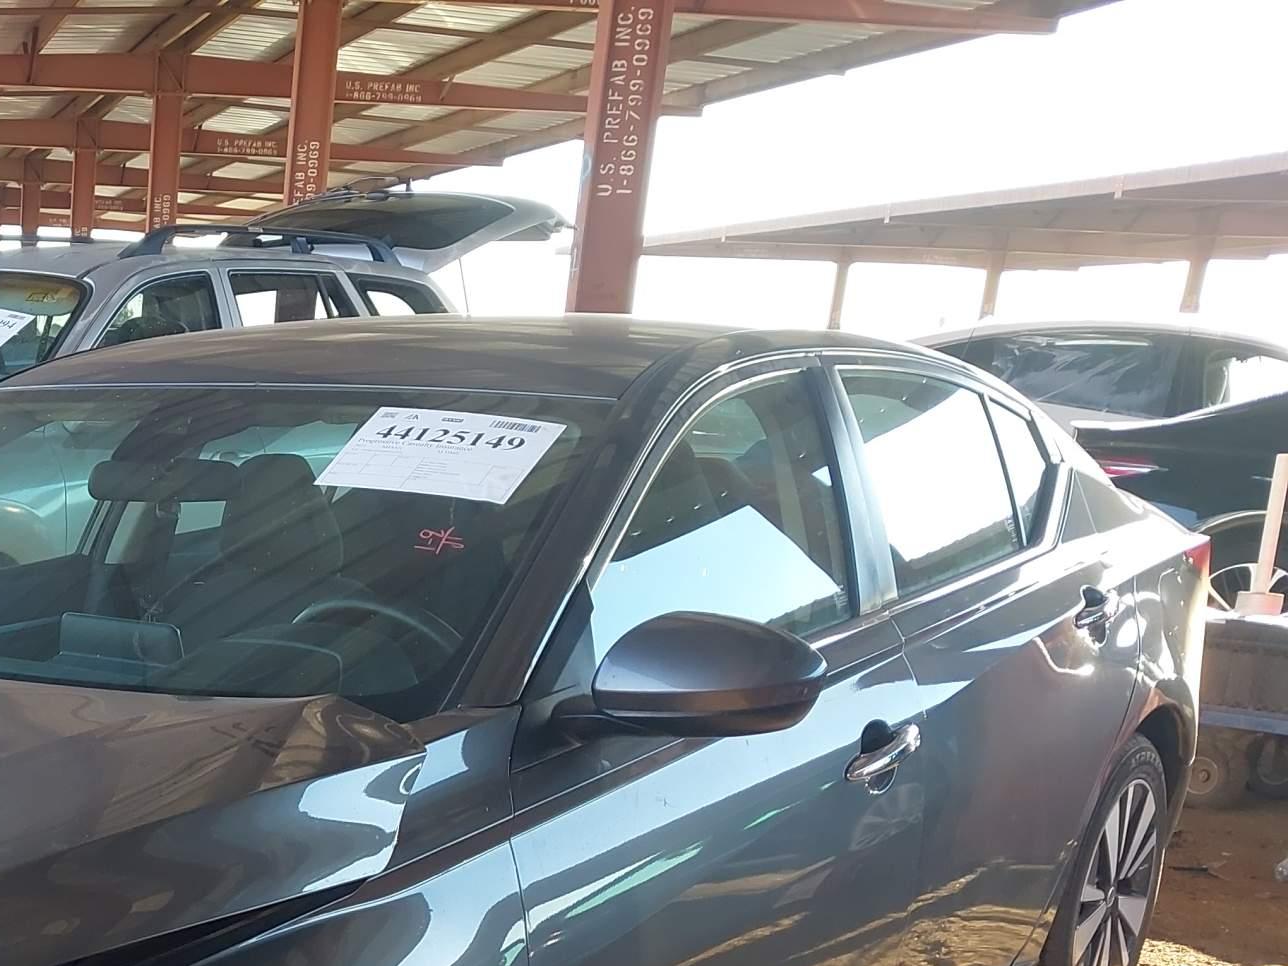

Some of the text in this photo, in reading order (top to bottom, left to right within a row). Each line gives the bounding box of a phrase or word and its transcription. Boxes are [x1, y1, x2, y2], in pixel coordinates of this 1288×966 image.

[345, 80, 364, 91] U.S.
[367, 81, 403, 92] PREFAB
[596, 5, 635, 197] U.S. PREFAB INC.
[615, 7, 654, 195] 1-866-799-0969
[296, 139, 309, 166] INC.
[375, 423, 526, 451] 44125149
